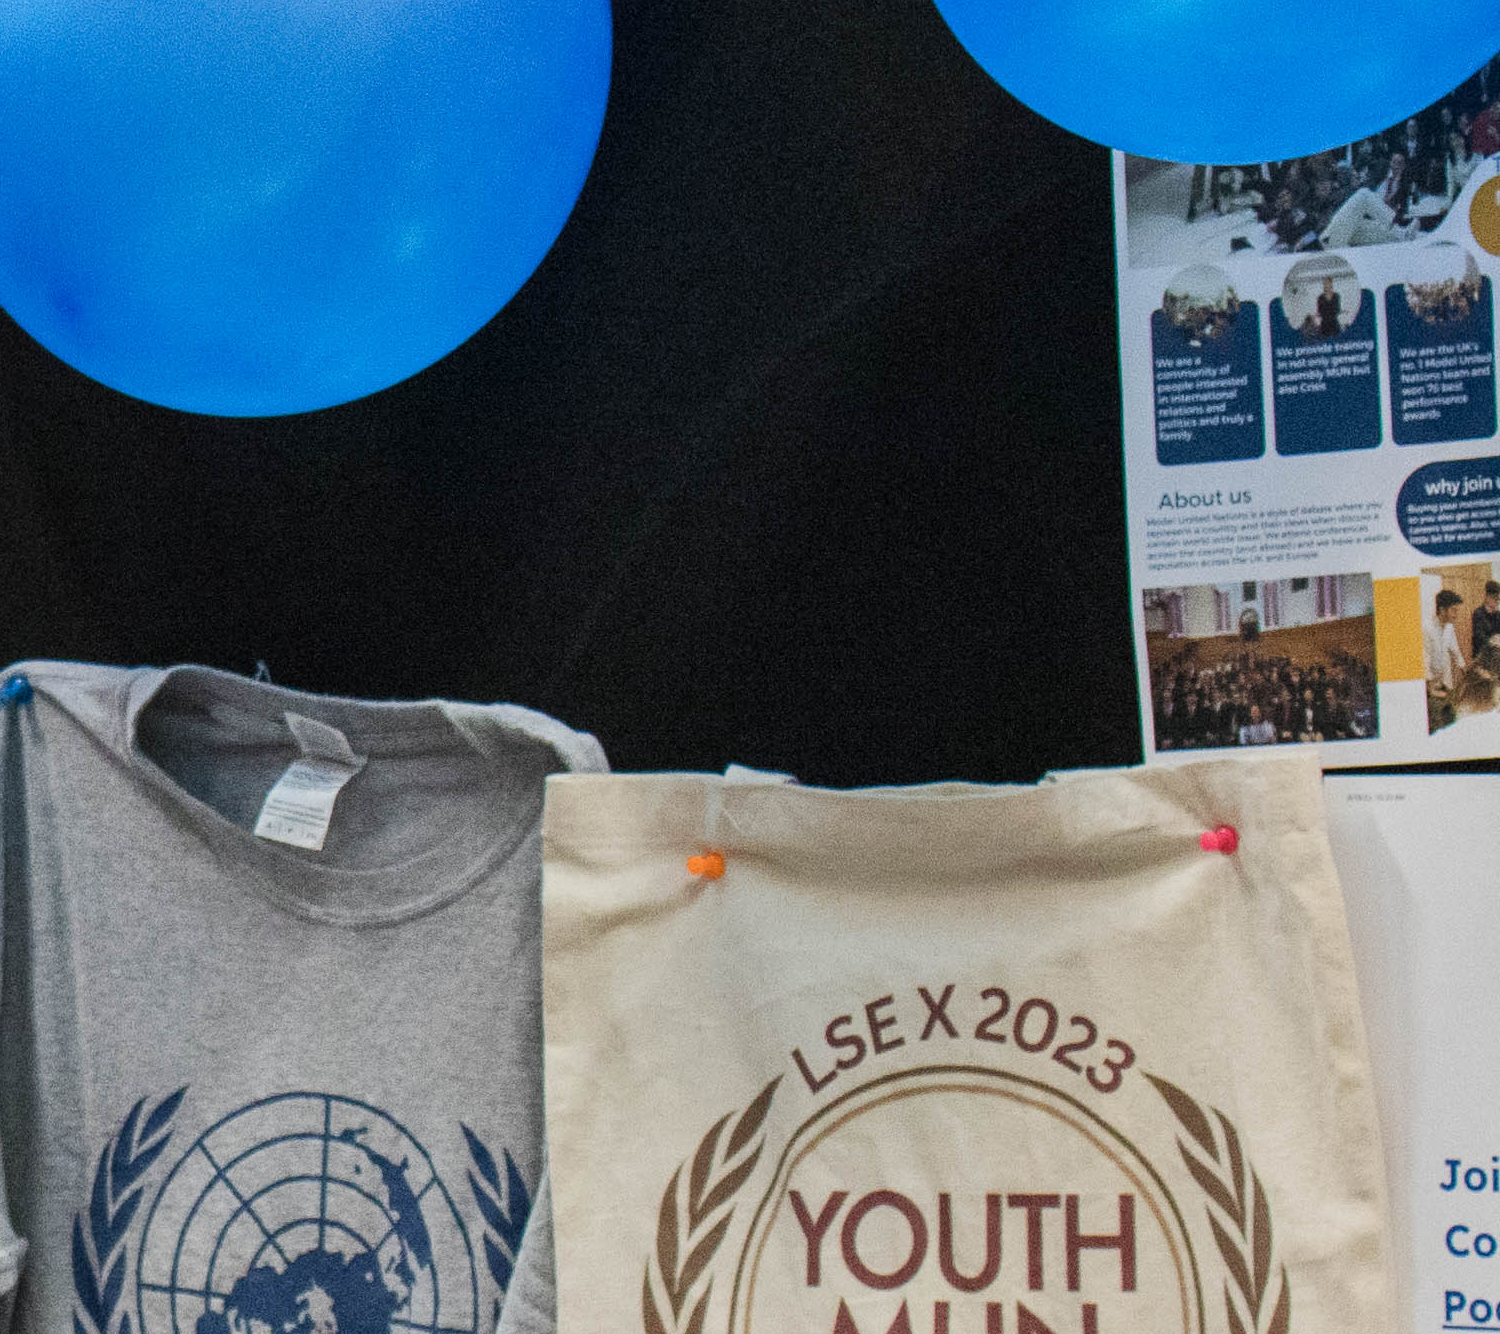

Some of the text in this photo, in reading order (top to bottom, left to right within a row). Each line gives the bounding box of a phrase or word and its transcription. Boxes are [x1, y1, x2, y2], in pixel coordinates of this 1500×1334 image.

[1158, 490, 1252, 509] About us
[1425, 475, 1493, 497] why join
[791, 984, 1137, 1096] LSE X 2023
[787, 1189, 1138, 1293] YOUTH
[1445, 1223, 1500, 1259] Co
